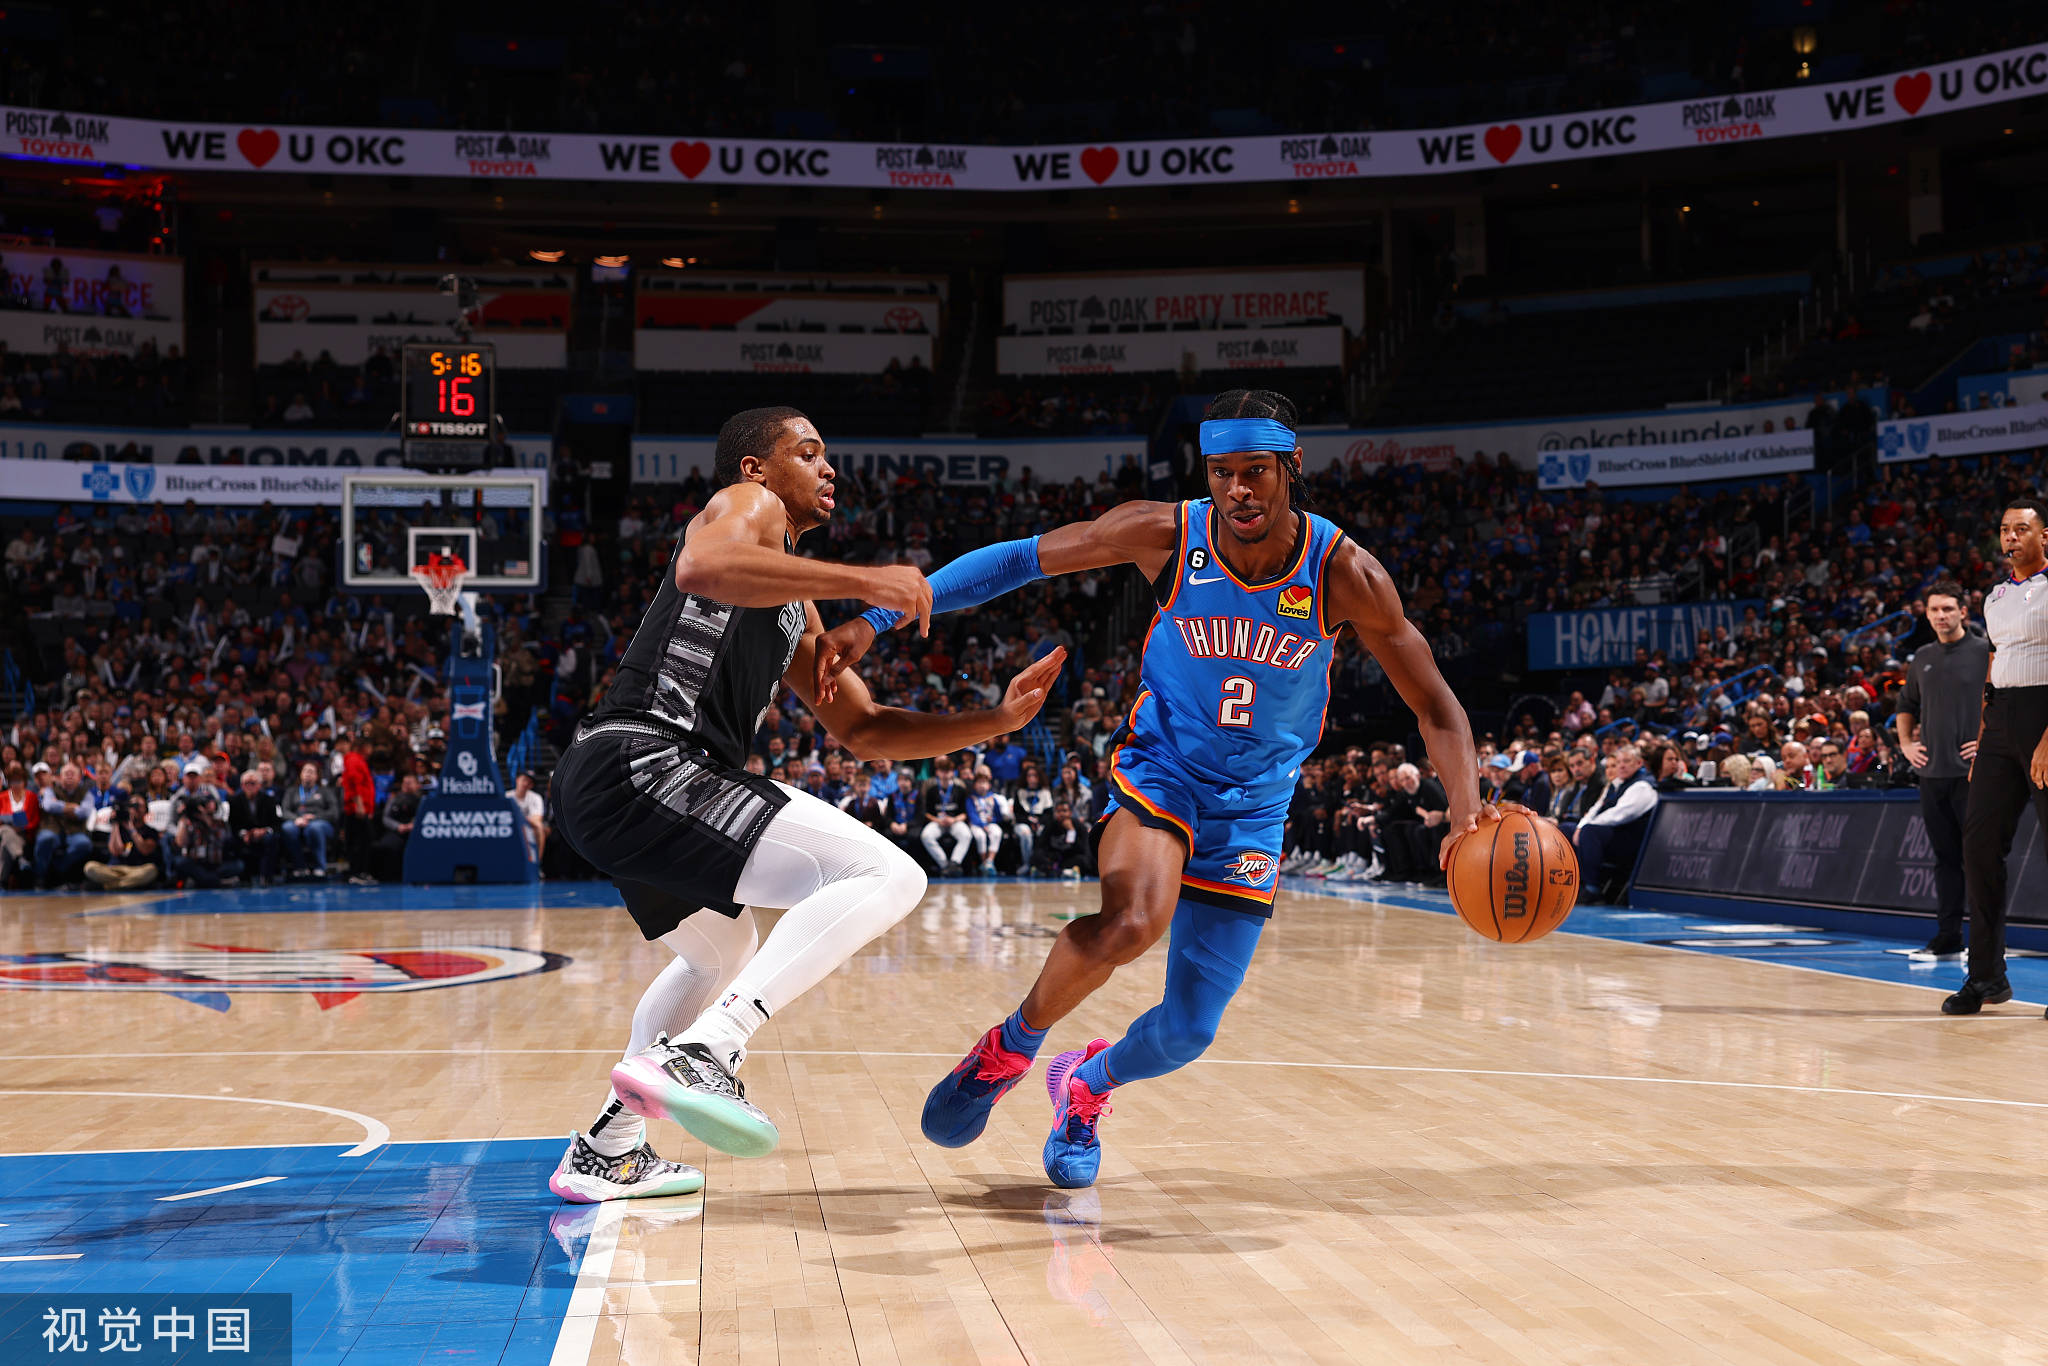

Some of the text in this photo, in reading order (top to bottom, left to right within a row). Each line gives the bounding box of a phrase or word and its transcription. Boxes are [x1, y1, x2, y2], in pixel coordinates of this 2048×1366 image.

[1826, 52, 2047, 121] WE U OKC
[1683, 96, 1775, 128] POST OAK
[5, 112, 108, 142] POST OAK
[1695, 123, 1762, 143] TOYOTA
[20, 138, 94, 158] TOYOTA
[162, 130, 405, 165] WE U OKC
[455, 136, 551, 159] POST OAK
[1280, 137, 1371, 160] POST OAK
[1418, 115, 1636, 165] WE U OKC
[468, 160, 537, 176] TOYOTA
[600, 143, 829, 176] WE U OKC
[876, 147, 966, 171] POST OAK
[1014, 147, 1234, 181] WE U OKC
[1293, 161, 1358, 177] TOYOTA
[889, 169, 952, 187] TOYOTA
[1030, 291, 1328, 325] POST OAK PARTY TERRACE
[742, 343, 824, 361] POST OAK
[1047, 345, 1126, 363] POST OAK
[1218, 340, 1298, 358] POST OAK
[430, 352, 482, 376] 5:16
[438, 377, 475, 416] 16
[1937, 425, 2007, 443] BlueCross
[1598, 455, 1667, 473] BlueCross
[1669, 447, 1736, 470] BlueShield
[165, 475, 257, 492] BlueCross
[260, 476, 341, 494] BlueShie
[1191, 550, 1205, 568] 6
[1173, 616, 1319, 670] THUNDER
[1217, 675, 1256, 728] 2
[442, 775, 496, 795] Health
[421, 811, 514, 825] ALWAYS
[420, 825, 514, 839] ONWARD
[1237, 860, 1268, 874] OKC
[1504, 832, 1530, 920] Wilson
